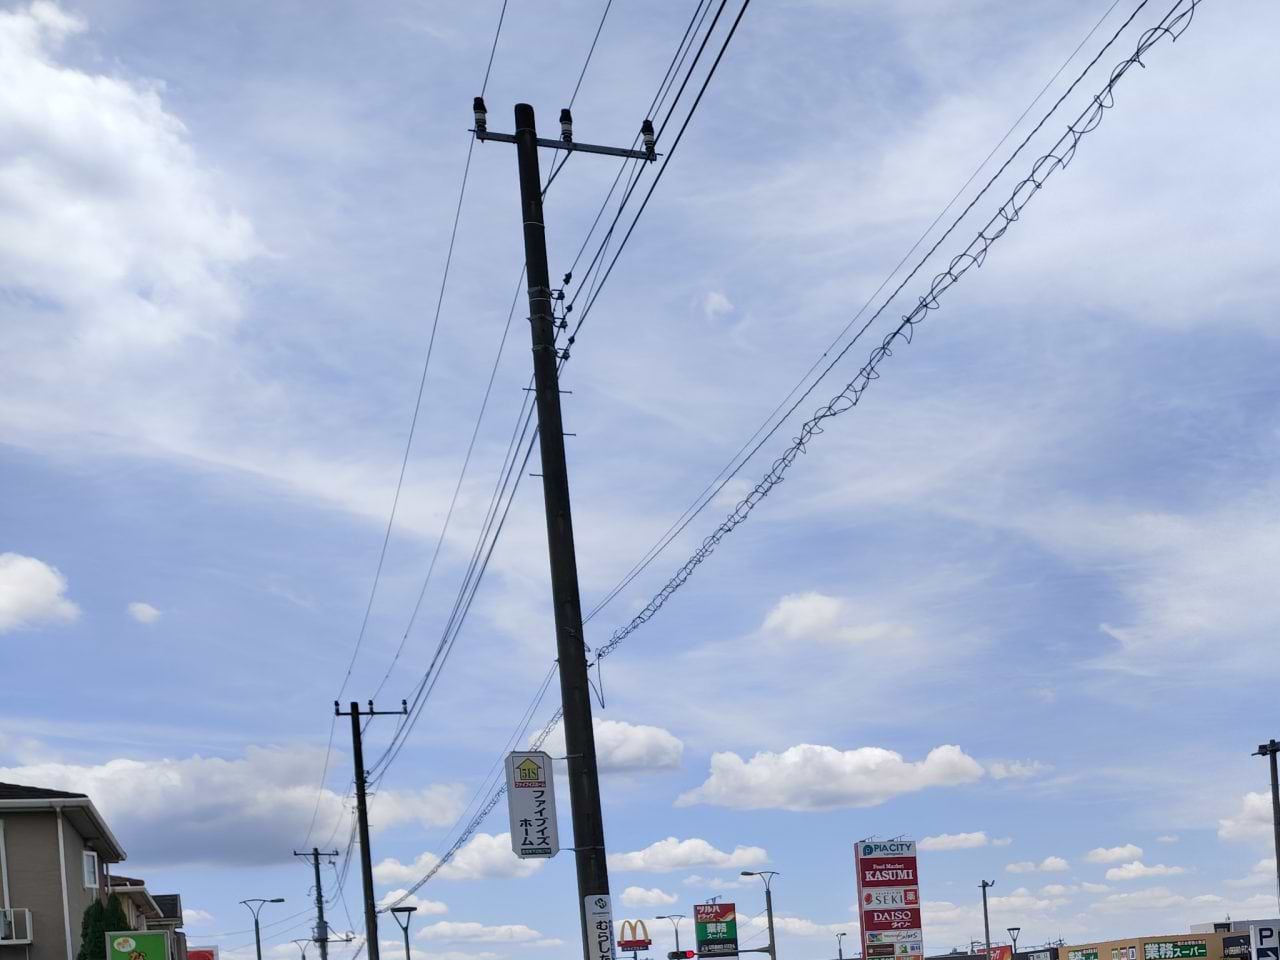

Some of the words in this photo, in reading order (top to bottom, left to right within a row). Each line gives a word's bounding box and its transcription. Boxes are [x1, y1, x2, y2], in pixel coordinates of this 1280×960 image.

[533, 790, 550, 846] ファイブイズ
[519, 818, 534, 846] ホーム
[865, 870, 913, 881] KASUMI
[875, 894, 903, 905] SEKI
[697, 905, 720, 913] ツルハ
[873, 911, 911, 920] DAISO
[1258, 927, 1274, 946] P
[1145, 943, 1207, 960] 業務スーパー
